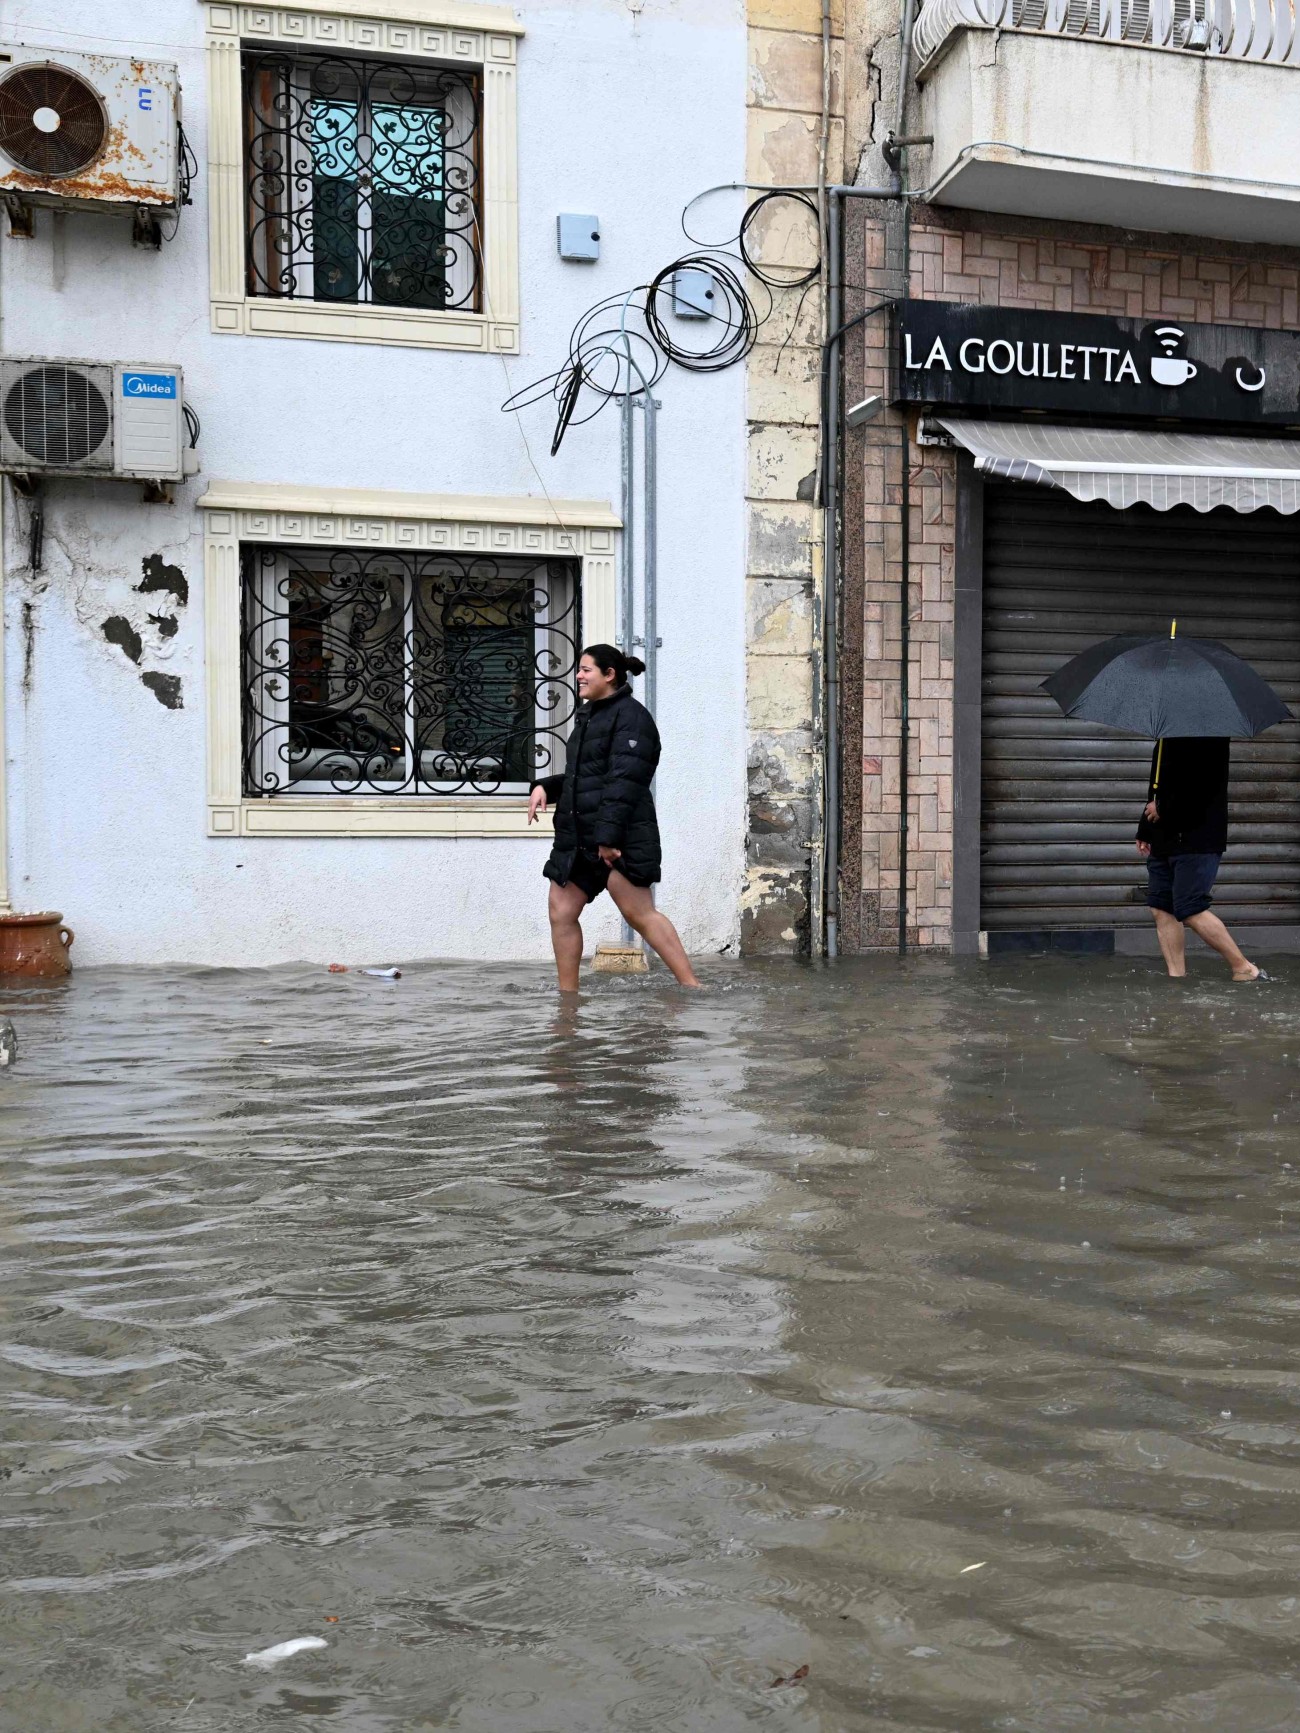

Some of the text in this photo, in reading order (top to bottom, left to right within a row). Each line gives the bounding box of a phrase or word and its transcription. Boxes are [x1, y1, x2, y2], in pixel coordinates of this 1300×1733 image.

[904, 333, 1142, 384] LA GOULETTA
[127, 377, 171, 394] Midea
